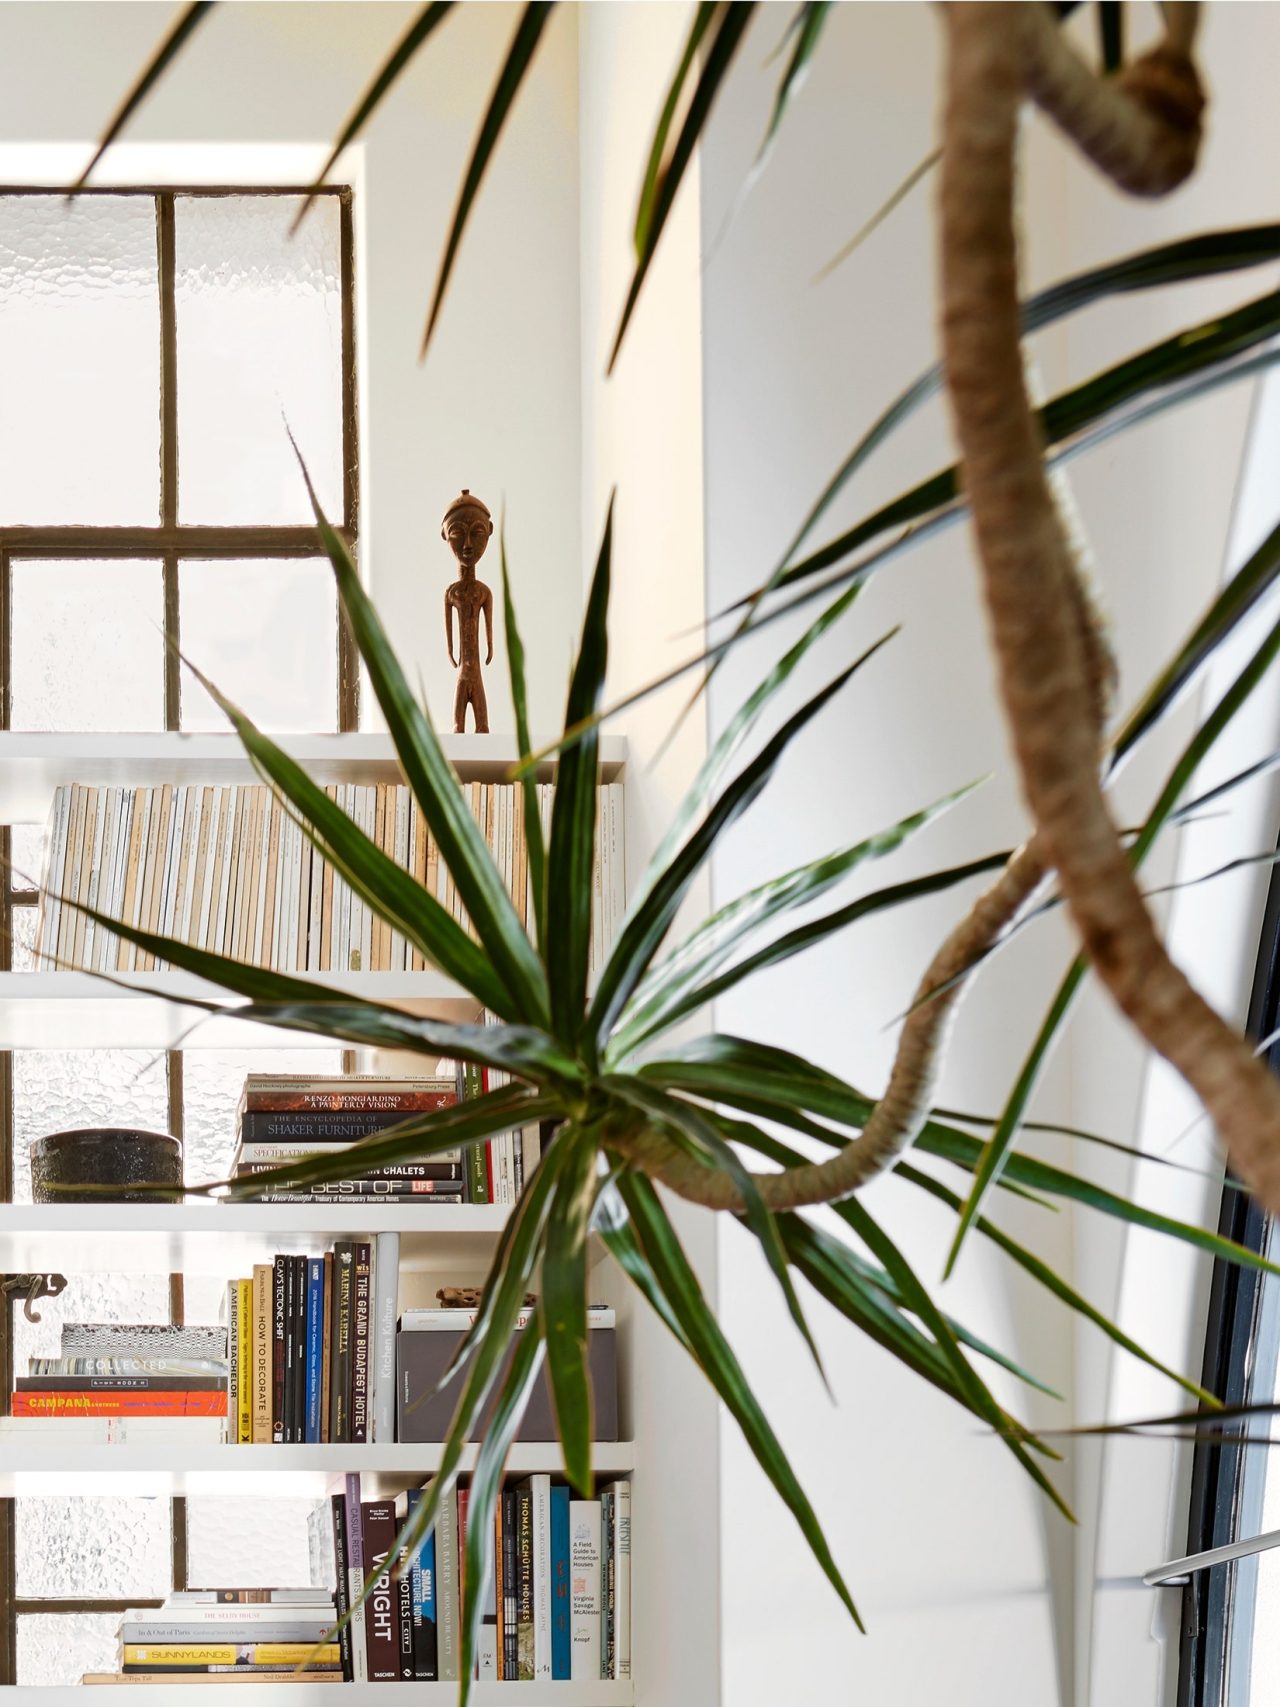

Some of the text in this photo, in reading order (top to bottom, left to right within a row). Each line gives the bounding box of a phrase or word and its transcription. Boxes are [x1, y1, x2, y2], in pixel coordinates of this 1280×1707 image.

[318, 1101, 362, 1109] PAINTERLY
[383, 1167, 425, 1175] CHALETS
[339, 1269, 350, 1353] MARINA KARELLA
[382, 1297, 393, 1378] Kitchen Kulture
[258, 1316, 266, 1411] HOW TO DECORATE
[355, 1277, 367, 1427] THE GRAND BUDAPEST HOTEL
[29, 1398, 91, 1408] CAMPANA
[372, 1552, 392, 1641] WRIGHT
[421, 1569, 431, 1602] SMALL
[521, 1498, 531, 1620] THOMAS SCHÜTTE HOUSES
[413, 1605, 422, 1626] NOW!
